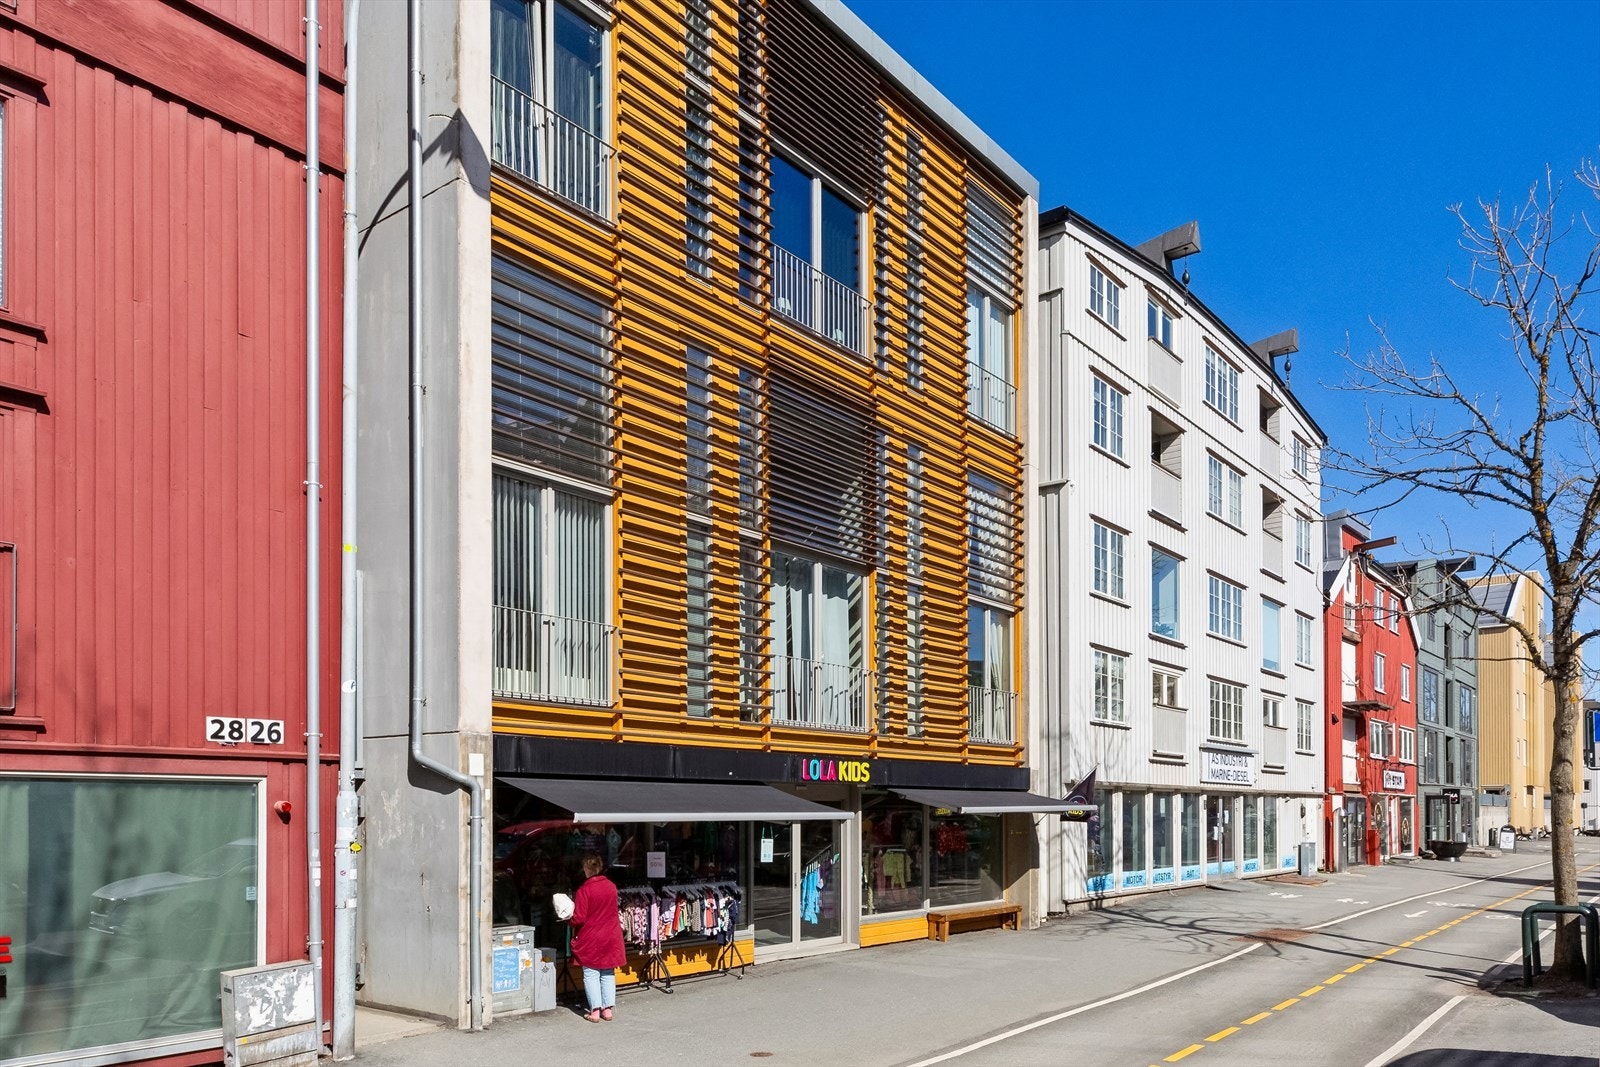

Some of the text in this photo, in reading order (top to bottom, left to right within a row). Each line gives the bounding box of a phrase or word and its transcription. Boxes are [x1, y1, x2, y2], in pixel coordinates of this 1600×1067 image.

[210, 719, 244, 741] 28
[250, 721, 282, 743] 26
[802, 758, 871, 783] LOLA KIDS
[1210, 768, 1250, 783] MARINE-DIESEL
